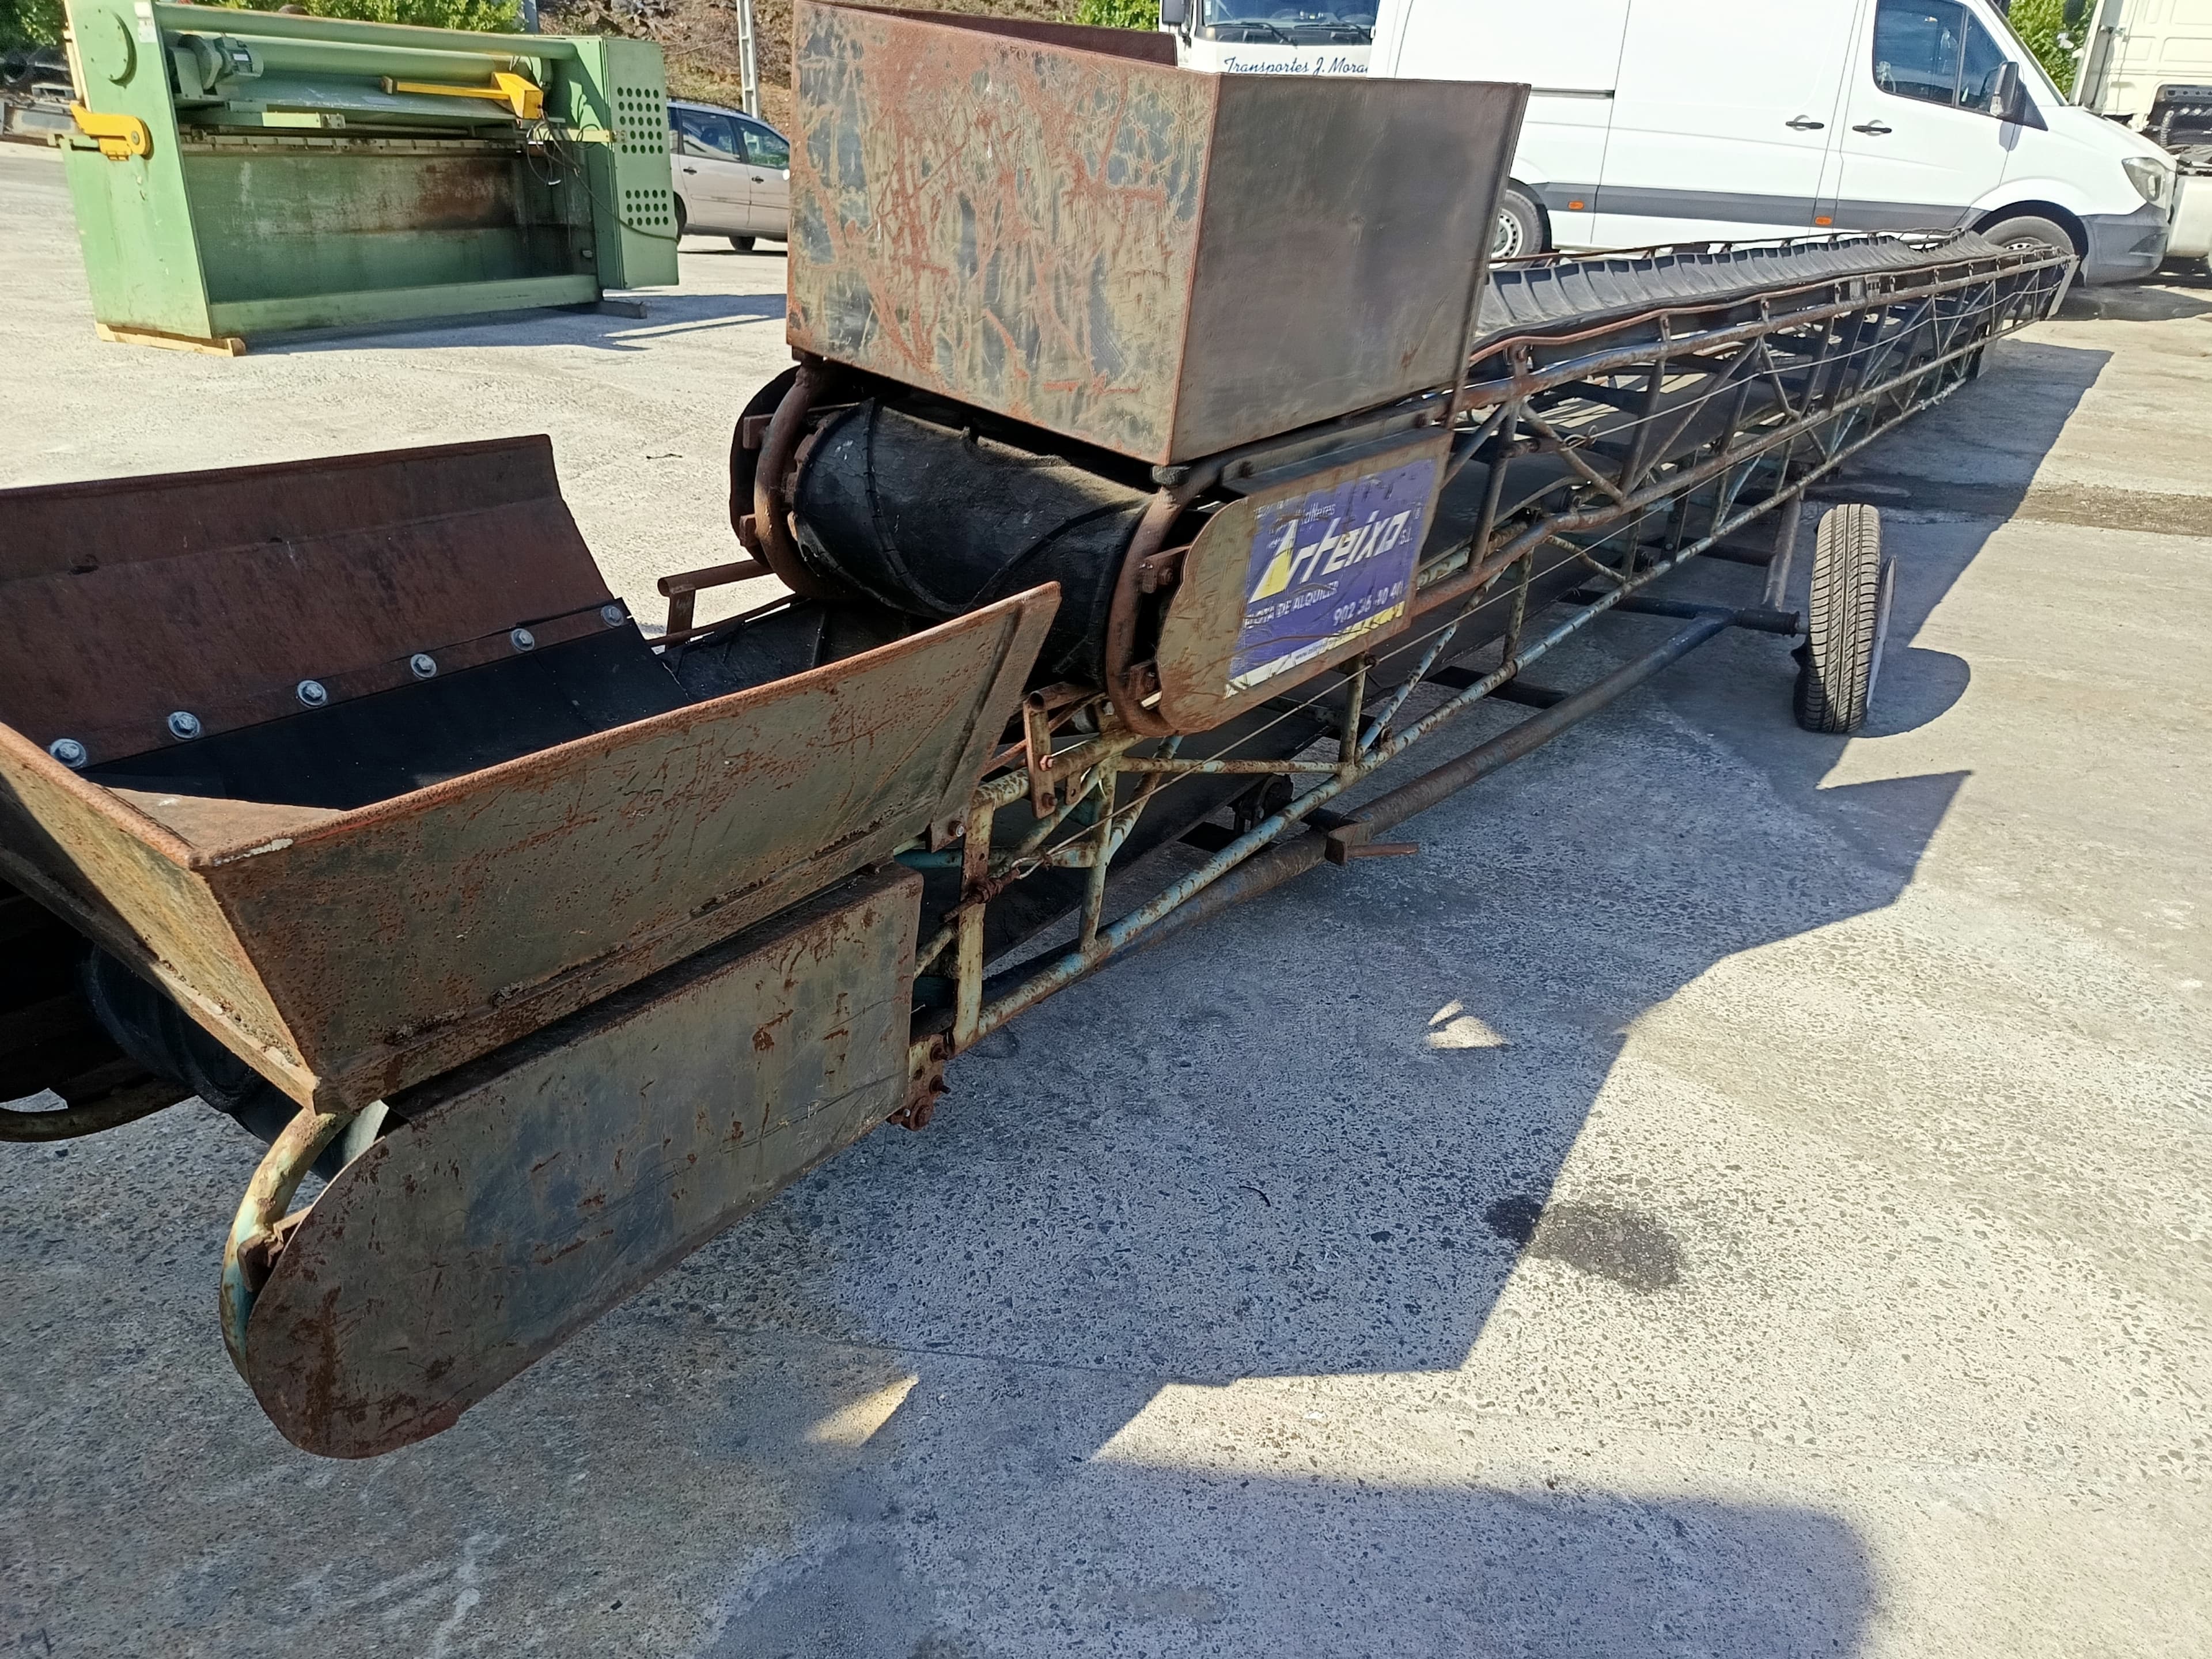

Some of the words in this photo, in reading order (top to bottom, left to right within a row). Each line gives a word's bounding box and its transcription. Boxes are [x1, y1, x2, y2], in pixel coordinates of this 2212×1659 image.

[1224, 56, 1309, 75] Transportes
[1313, 56, 1324, 76] J.
[1248, 509, 1411, 604] Arteixo
[1276, 600, 1292, 618] DE
[1333, 601, 1356, 627] 902
